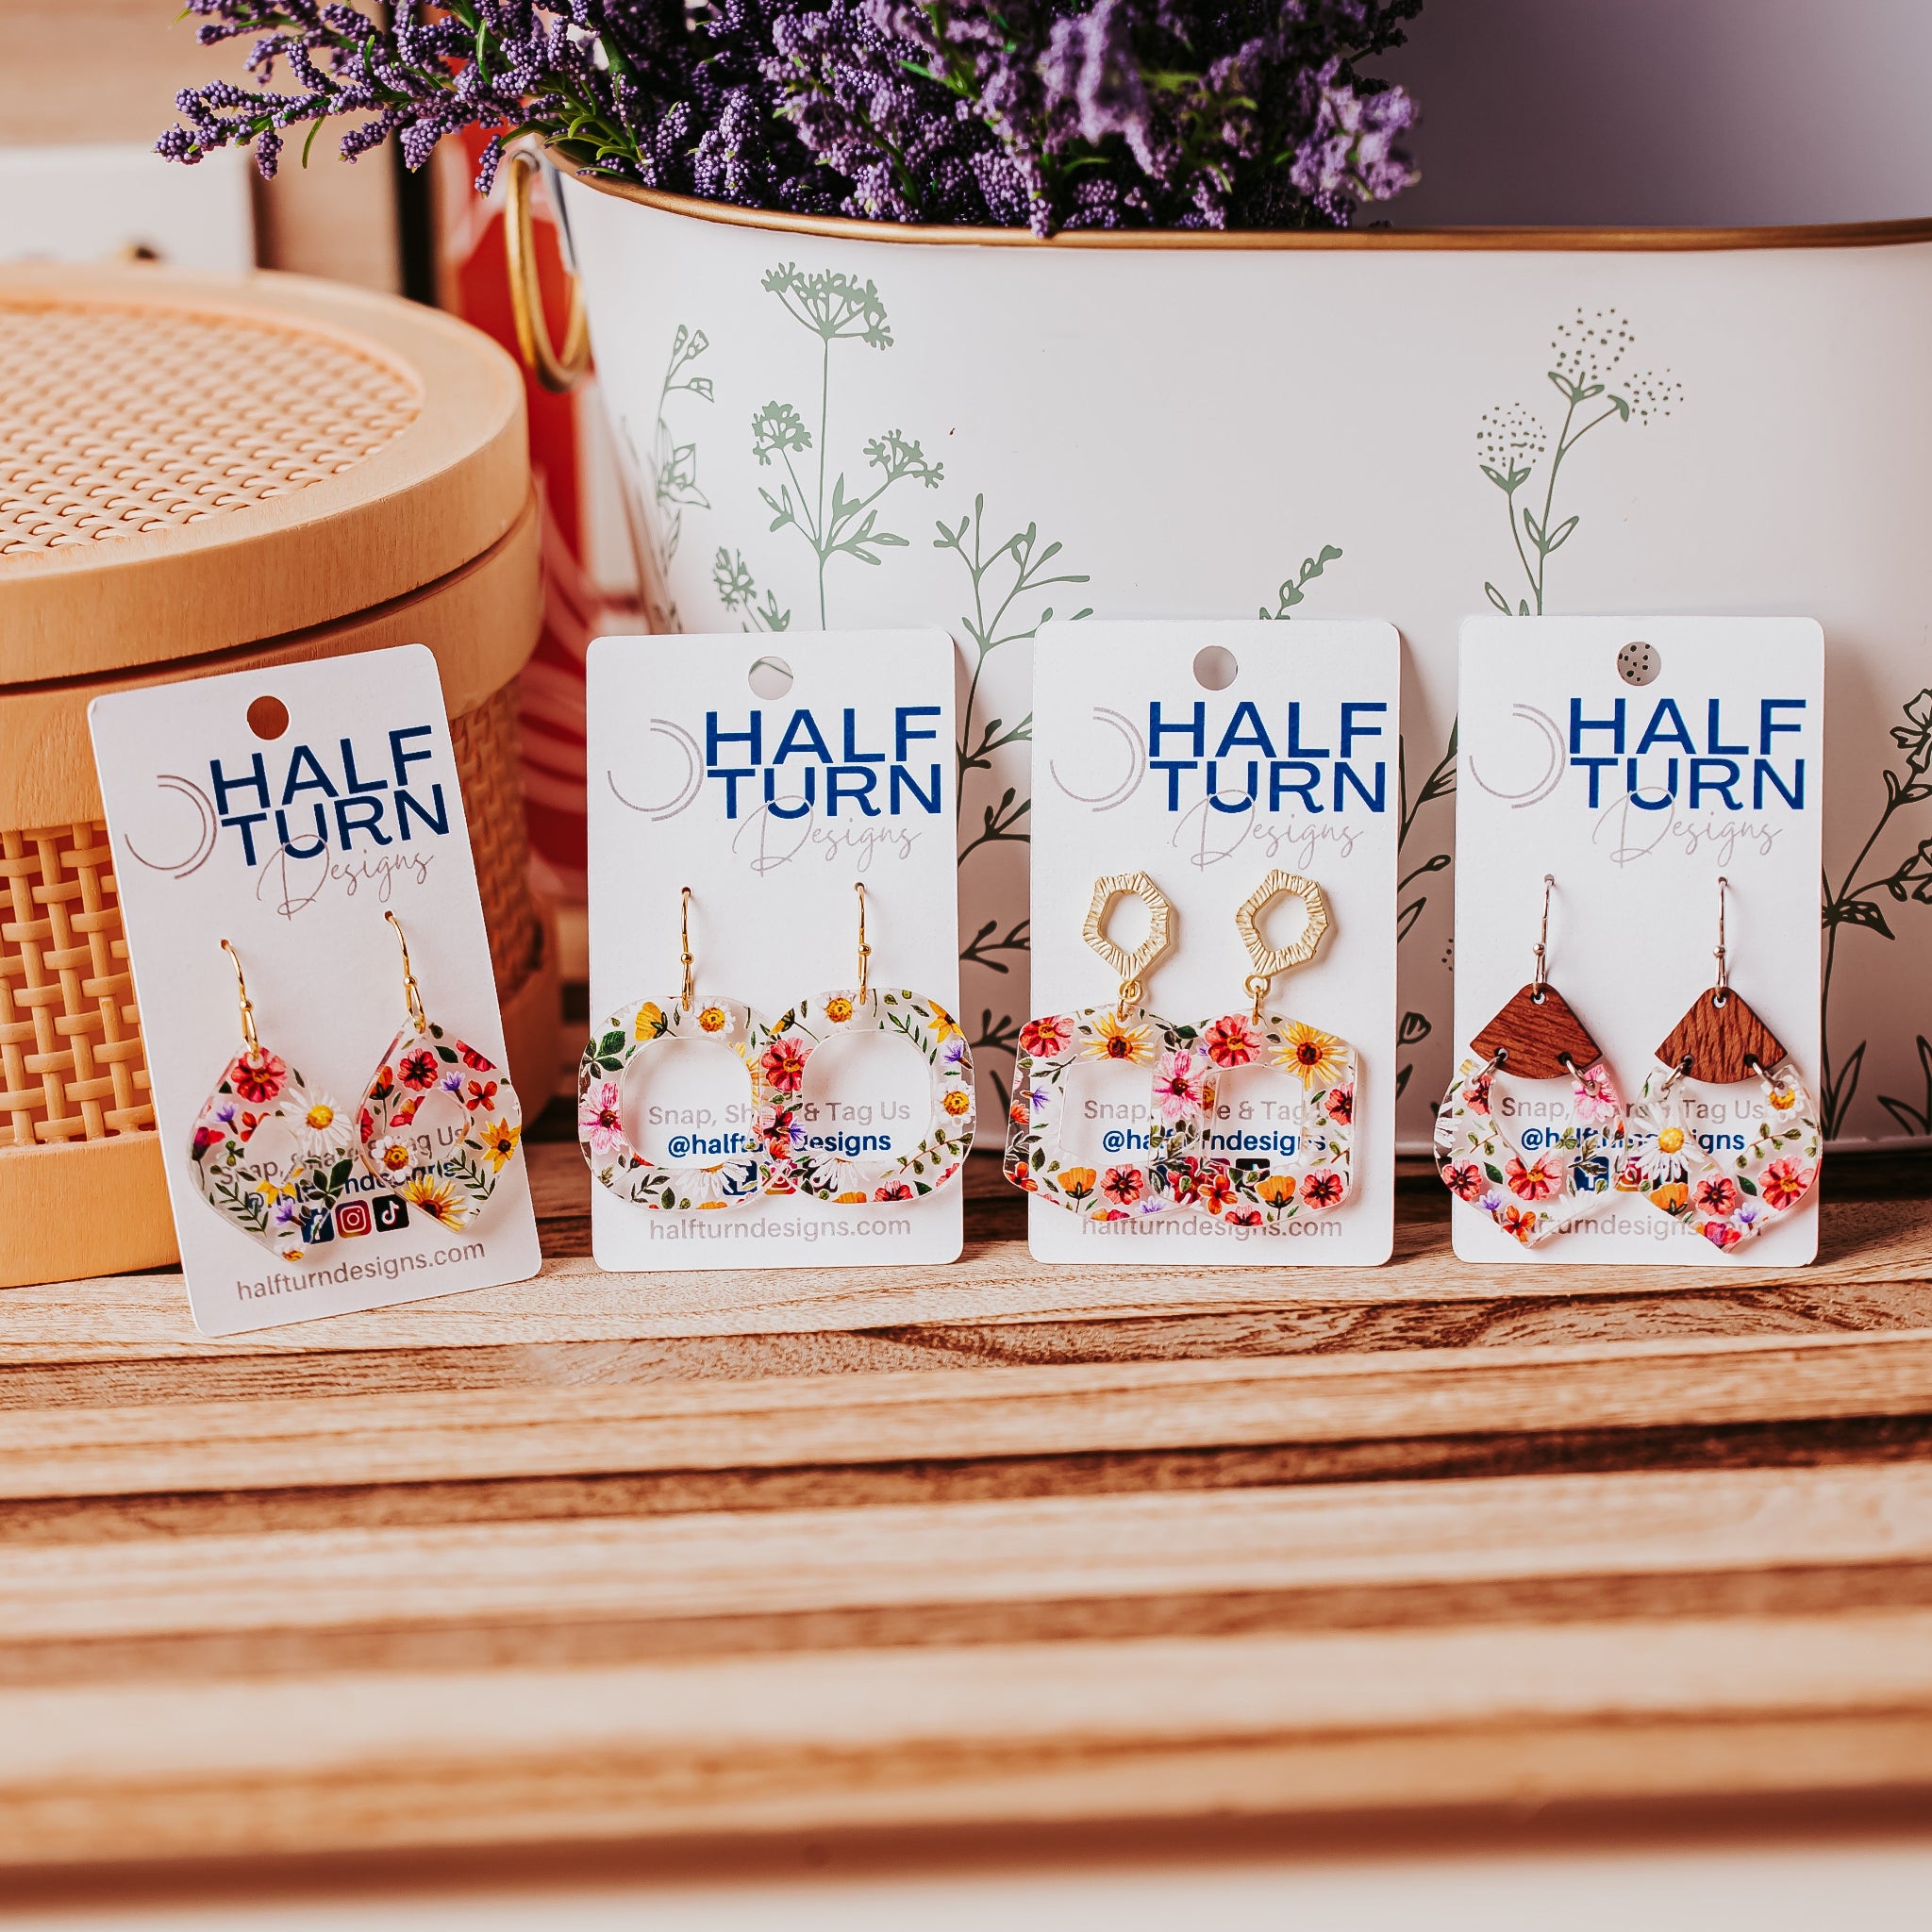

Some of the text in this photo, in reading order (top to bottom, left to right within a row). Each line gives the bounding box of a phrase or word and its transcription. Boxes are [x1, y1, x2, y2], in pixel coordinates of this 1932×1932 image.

[706, 707, 941, 767] HALF
[1149, 701, 1388, 758] HALF
[1569, 697, 1807, 756] HALF
[209, 724, 433, 816] HALF
[707, 763, 941, 820] TURN
[1149, 760, 1387, 814] TURN
[1570, 758, 1806, 811] TURN
[221, 783, 450, 867] TURN
[732, 794, 923, 878] Designs
[1172, 789, 1364, 873] Designs
[1591, 786, 1784, 869] Designs
[256, 834, 435, 921] Designs
[648, 1105, 718, 1130] Snap,
[804, 1102, 820, 1123] &
[825, 1102, 874, 1126] Tag
[881, 1101, 911, 1121] Us
[1239, 1100, 1255, 1121] &
[1501, 1096, 1571, 1123] Snap,
[1682, 1099, 1726, 1124] Tag
[1735, 1099, 1765, 1120] Us
[650, 1216, 911, 1242] halfturndesigns.com
[237, 1241, 486, 1301] halfturndesigns.com
